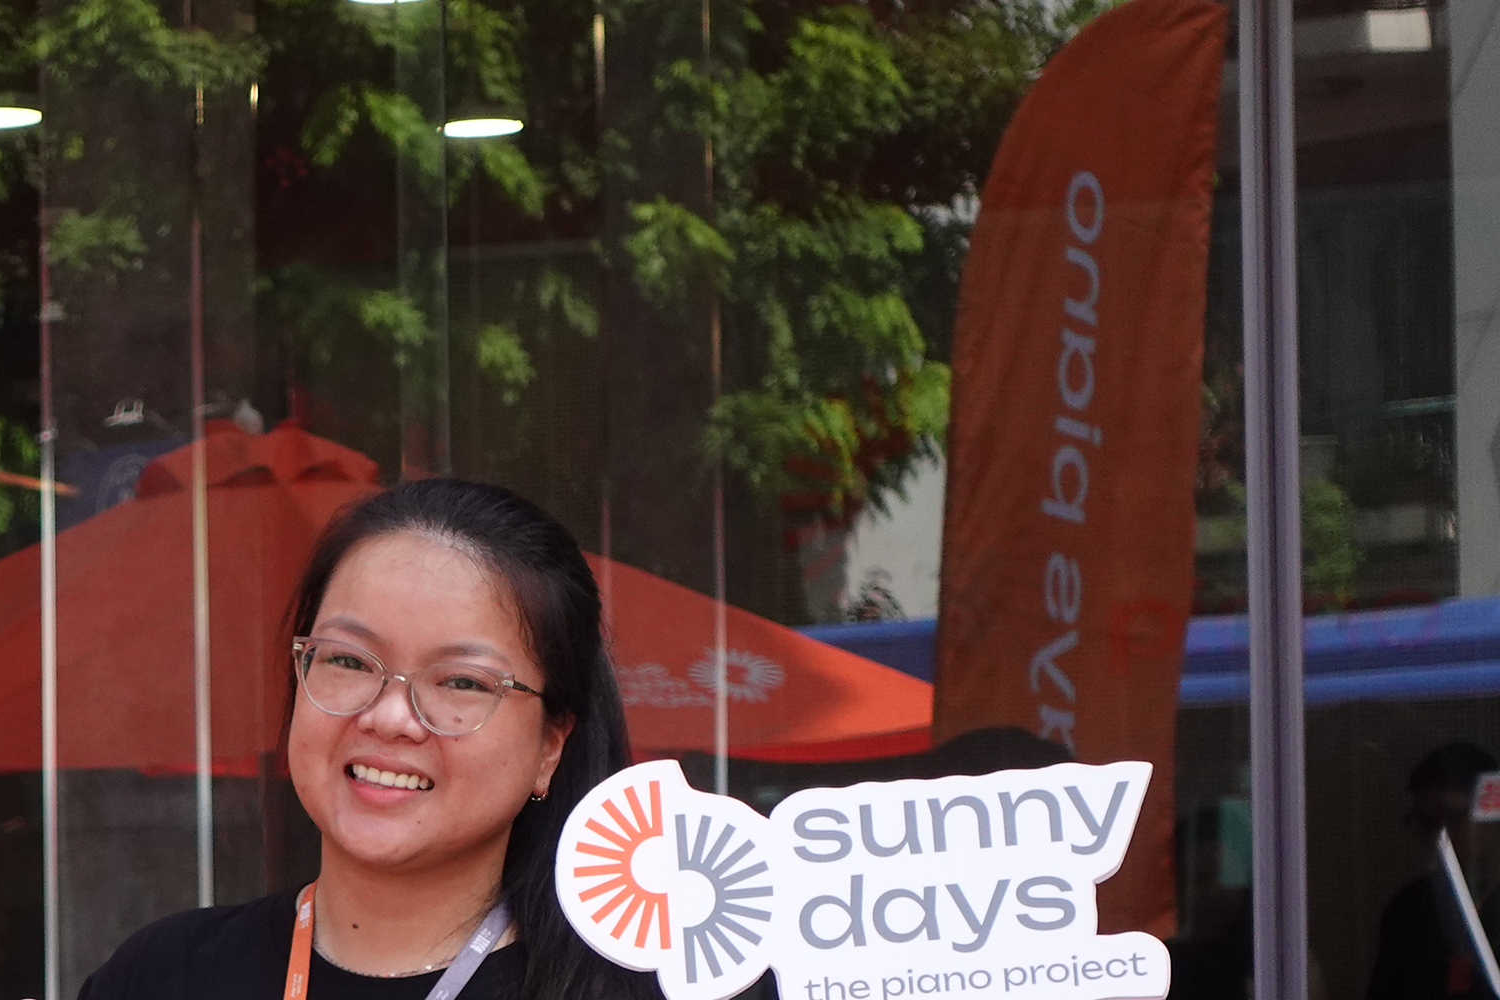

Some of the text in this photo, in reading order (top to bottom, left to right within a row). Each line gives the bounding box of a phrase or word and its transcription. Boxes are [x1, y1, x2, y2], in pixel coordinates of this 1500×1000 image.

[792, 780, 1130, 864] sunny
[798, 873, 1077, 953] days
[1003, 951, 1148, 992] project
